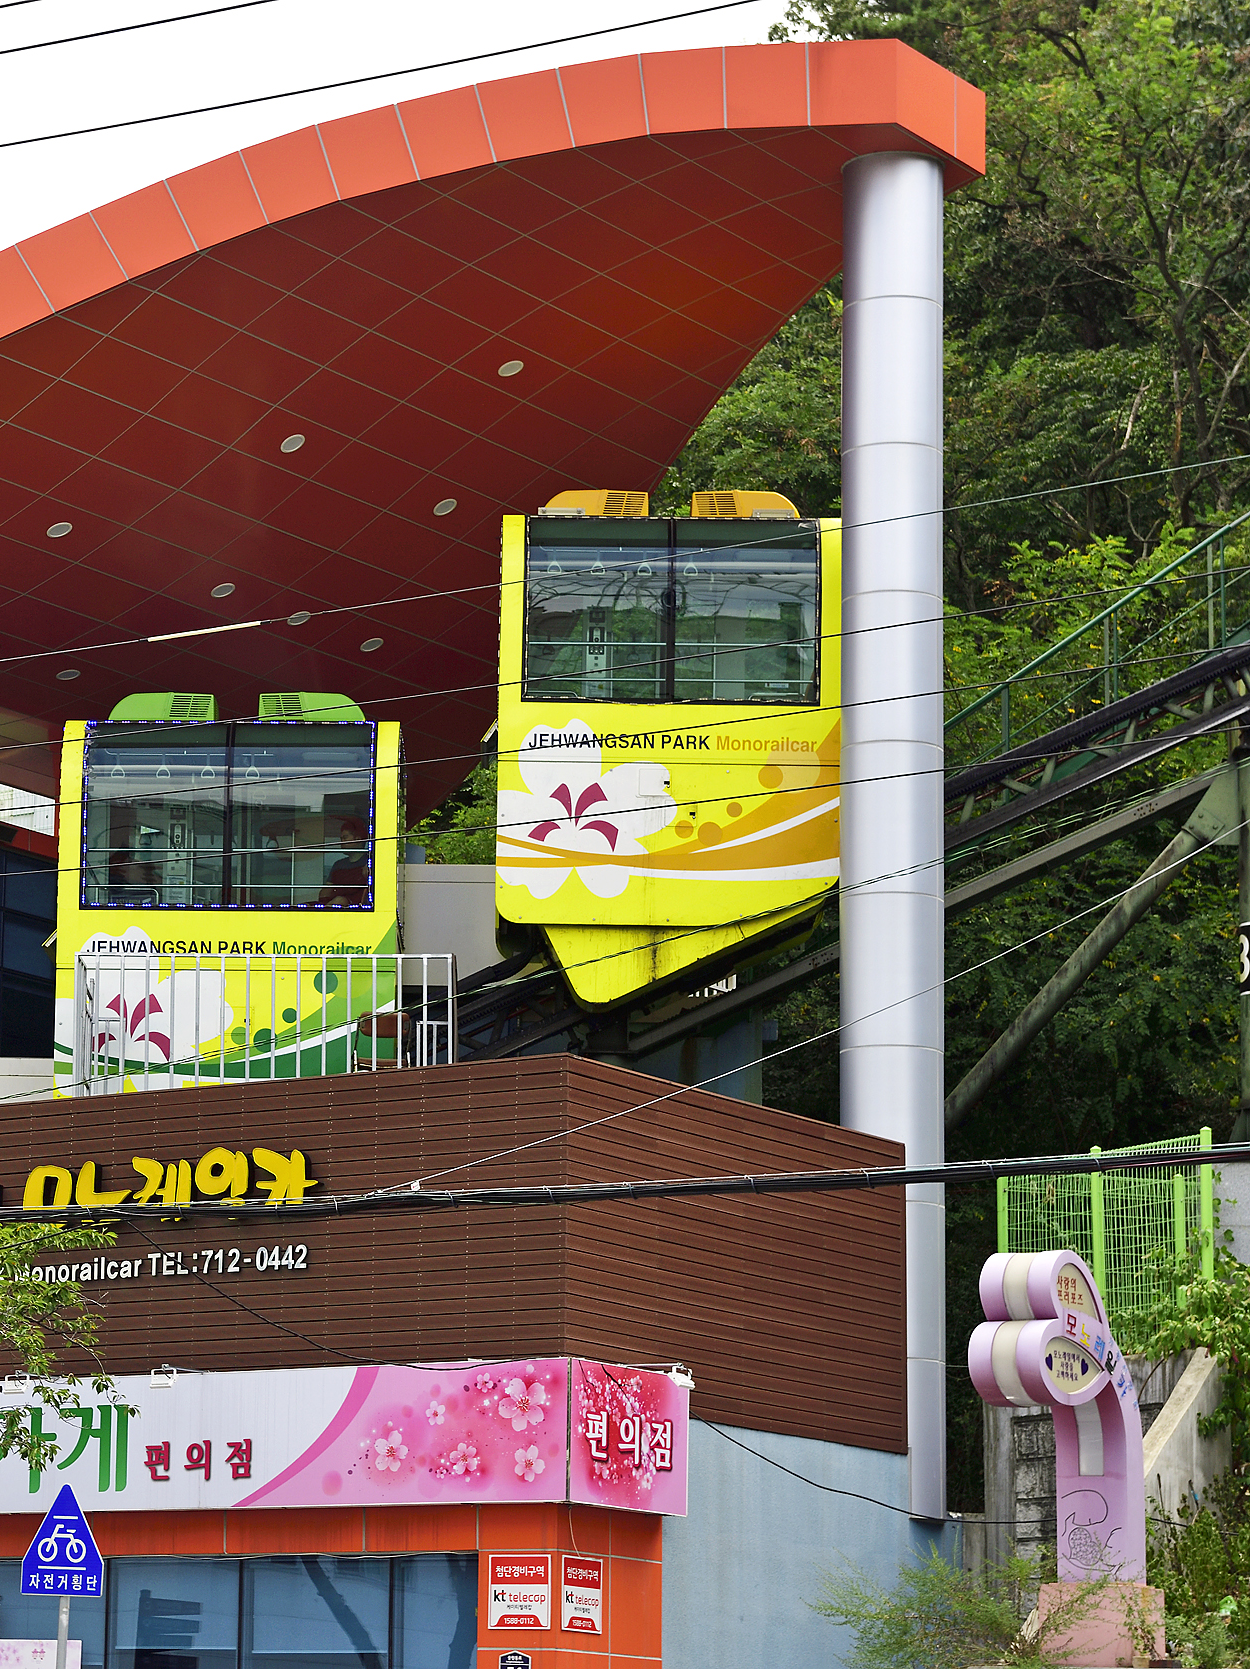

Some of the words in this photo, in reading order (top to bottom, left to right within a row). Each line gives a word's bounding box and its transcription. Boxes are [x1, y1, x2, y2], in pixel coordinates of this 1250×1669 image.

[528, 733, 655, 750] JEHWANGSAN
[661, 735, 710, 751] PARK
[716, 735, 817, 753] Monorailcar
[87, 940, 212, 955] JEHWANGSAN
[218, 941, 266, 955] PARK
[273, 941, 372, 956] Monorailcar
[1057, 1276, 1076, 1291] 사랑의
[585, 1410, 672, 1468] 편의점
[144, 1439, 251, 1480] 편의점
[495, 1566, 545, 1578] 첨단경비구역
[29, 1573, 97, 1591] 자전거횡단
[494, 1590, 506, 1602] kt
[509, 1592, 546, 1604] telecop
[565, 1591, 575, 1604] kt
[575, 1594, 599, 1609] telecop
[504, 1617, 534, 1625] 1588-0112
